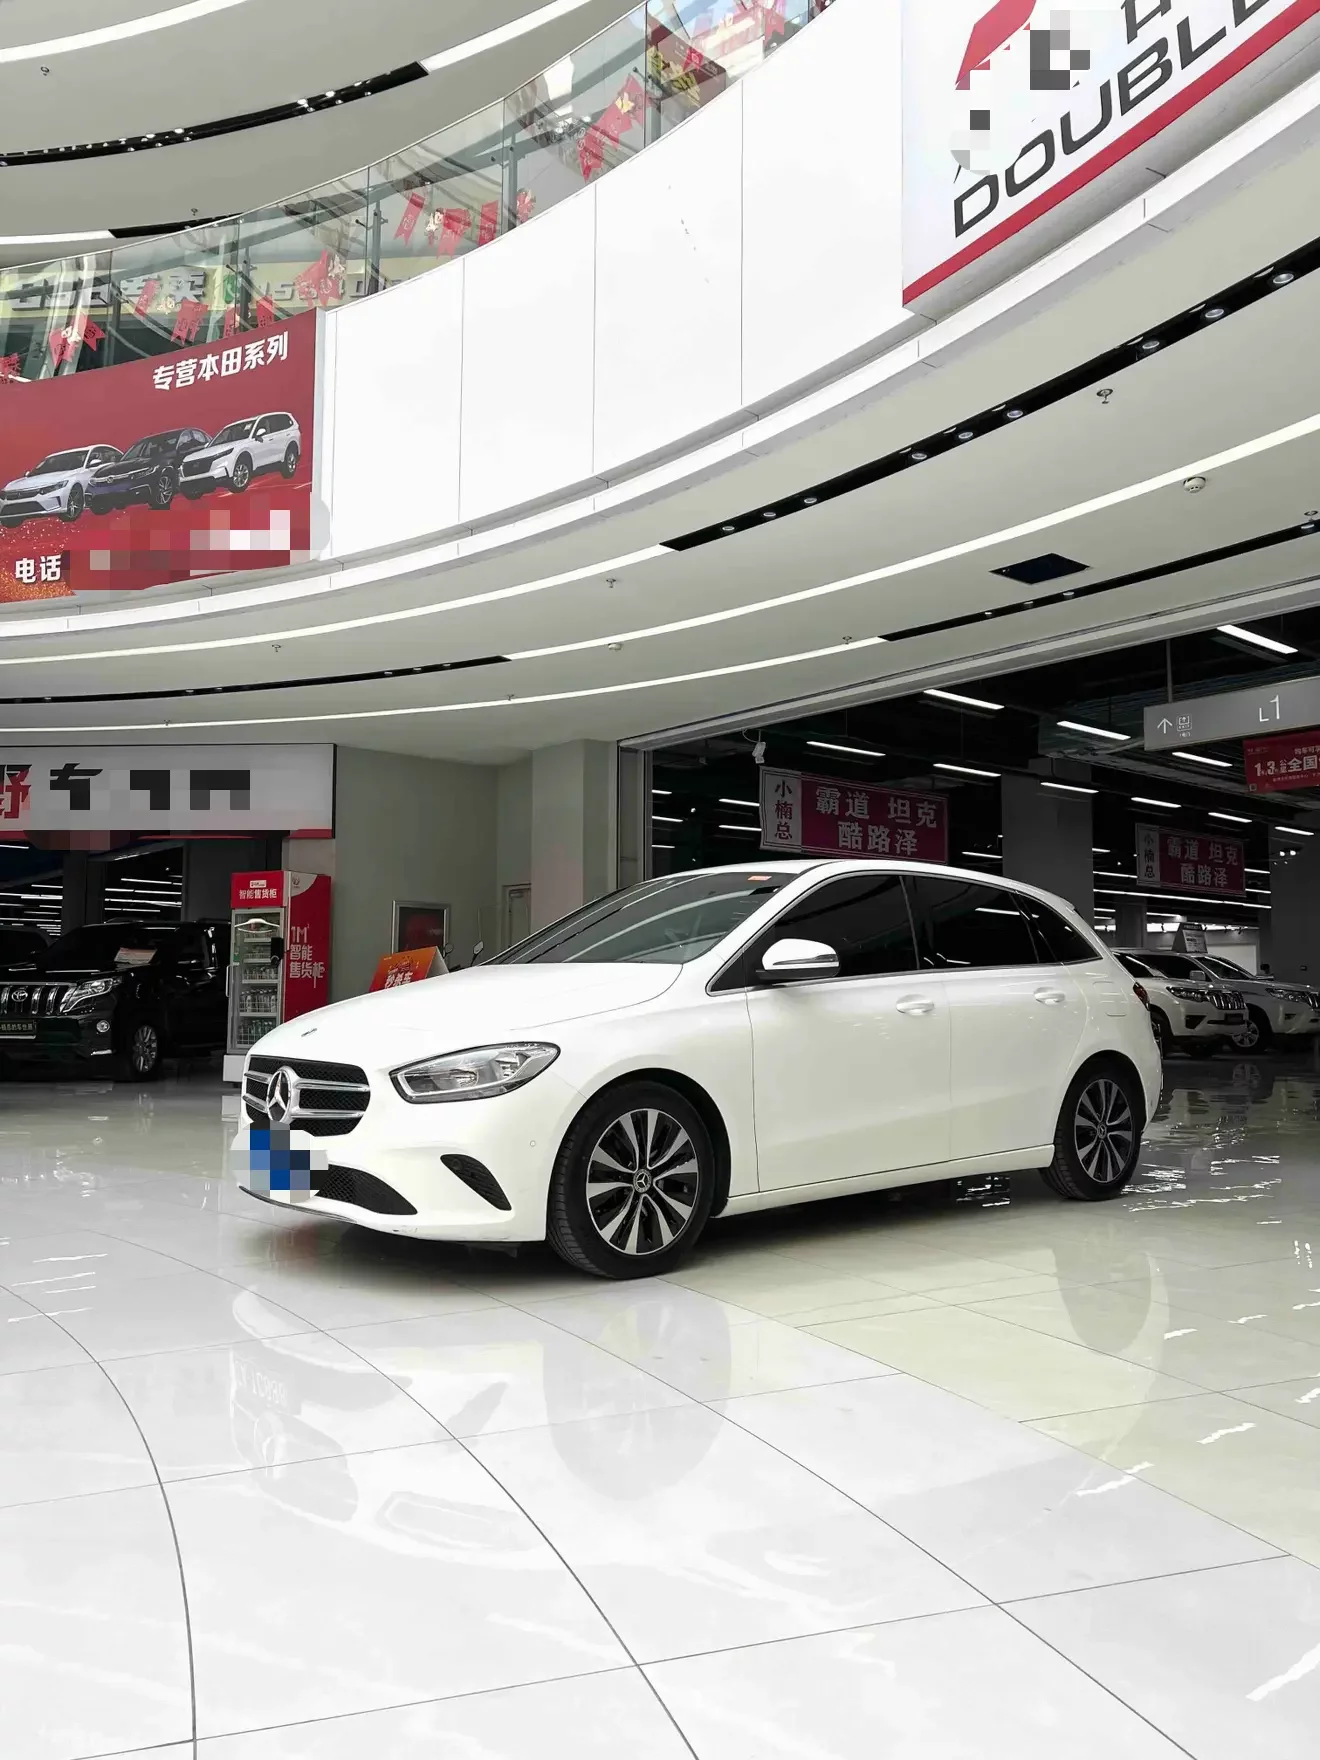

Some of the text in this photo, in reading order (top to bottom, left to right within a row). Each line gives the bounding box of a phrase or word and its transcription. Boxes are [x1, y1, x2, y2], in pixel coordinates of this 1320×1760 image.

[152, 330, 289, 391] 专营本田系列
[15, 554, 62, 584] 电话
[1259, 694, 1281, 722] L1
[774, 780, 793, 840] 小楠总
[815, 787, 938, 829] 霸道 坦克
[837, 820, 918, 856] 酷路泽
[239, 888, 278, 900] 智能售货柜
[289, 944, 313, 961] 智能
[289, 961, 325, 989] 售货柜
